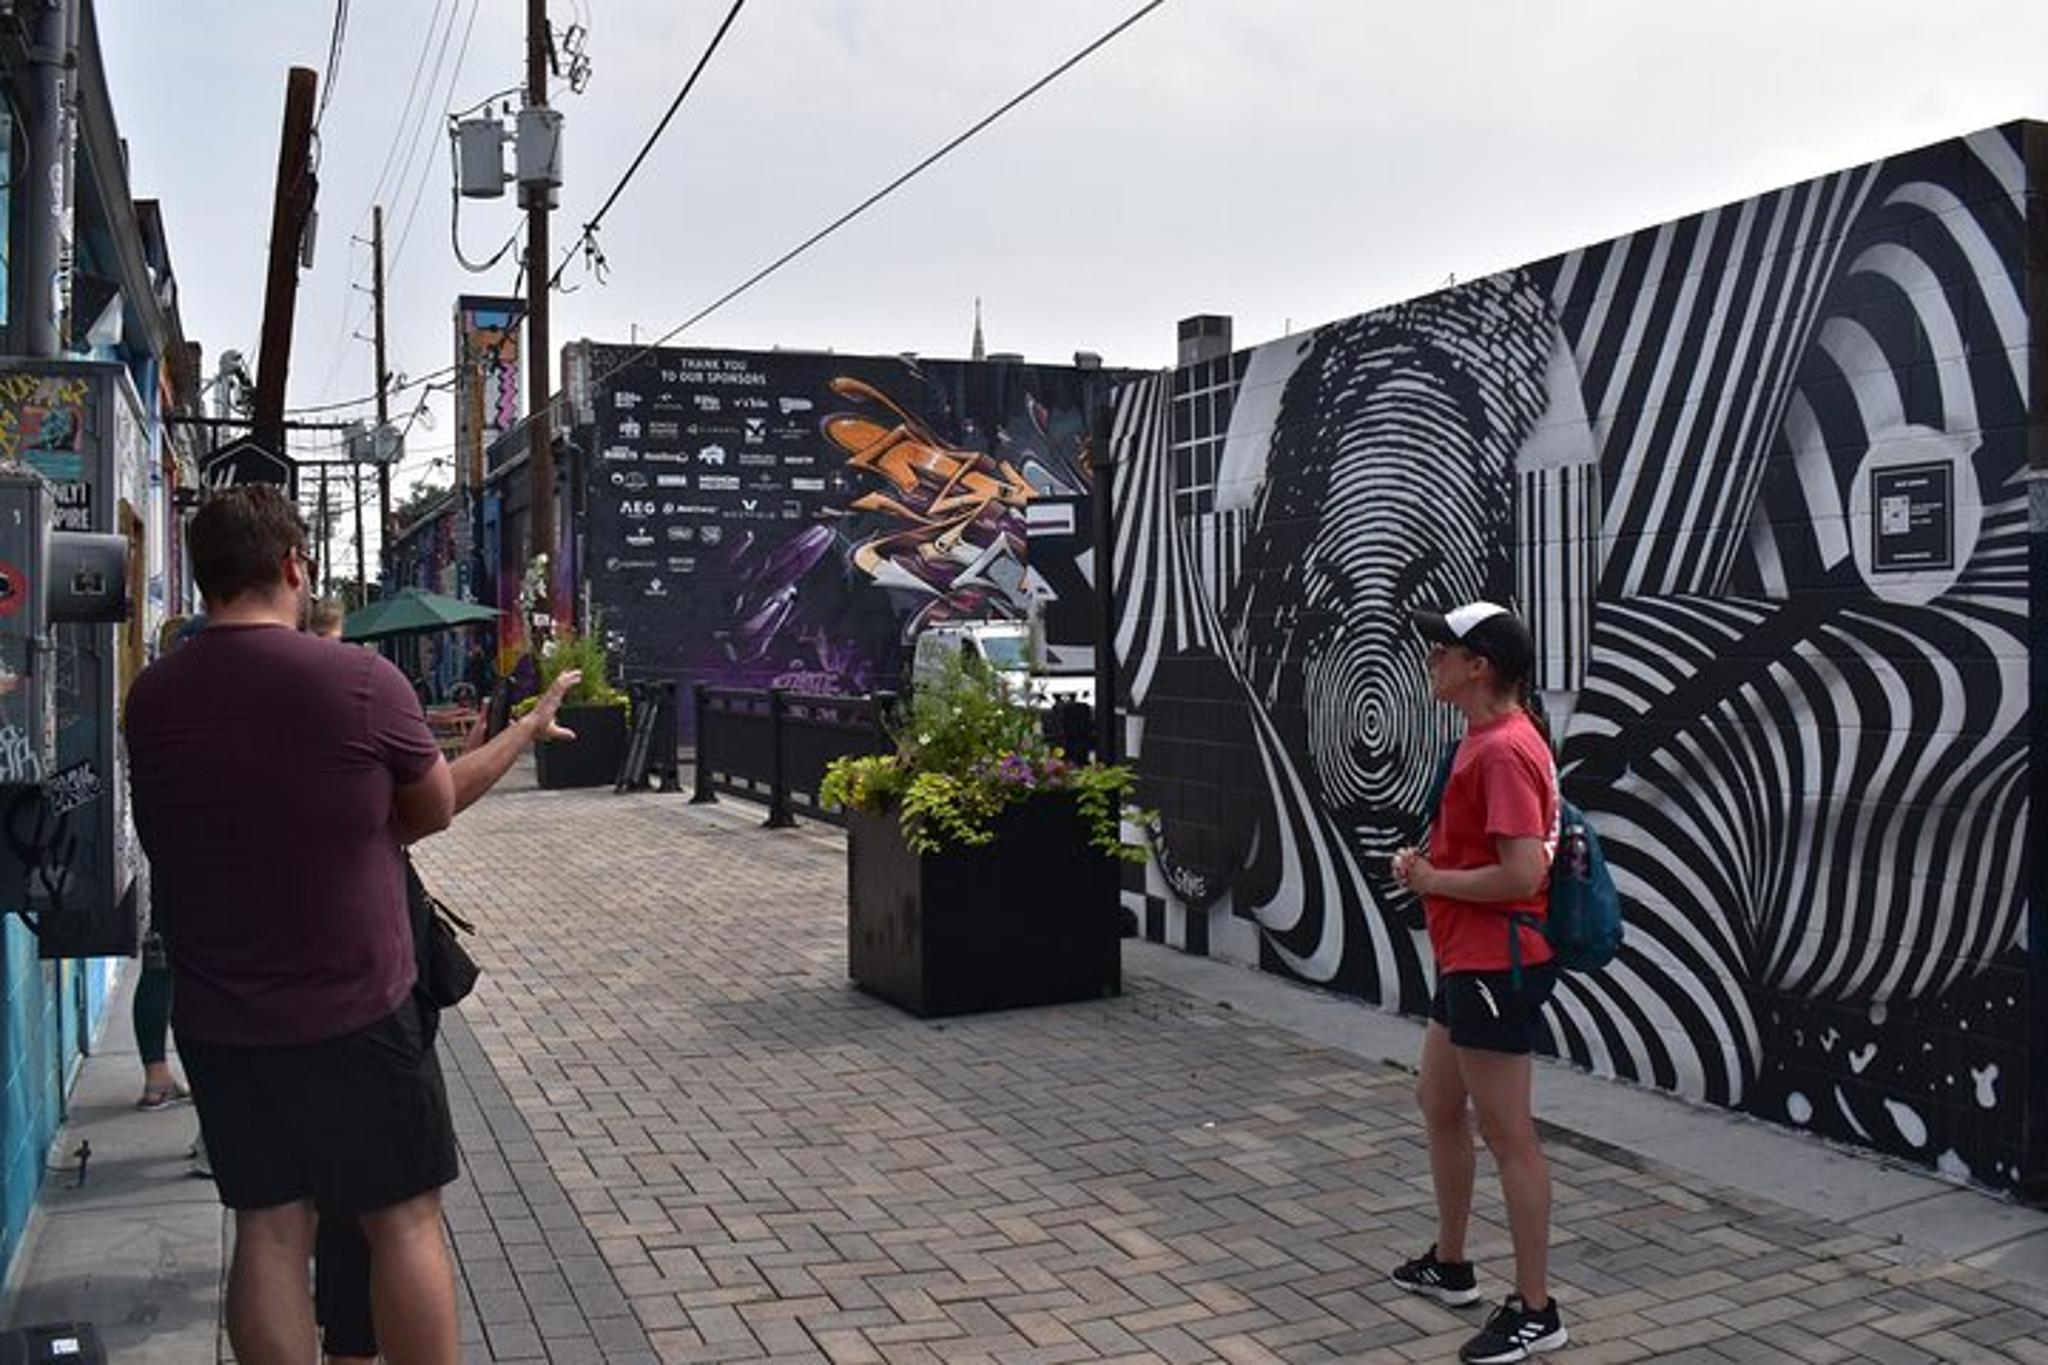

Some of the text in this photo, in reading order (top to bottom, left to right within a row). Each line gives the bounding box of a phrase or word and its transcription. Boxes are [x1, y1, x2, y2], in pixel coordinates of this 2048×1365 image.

[682, 358, 748, 371] THANK YOU
[661, 369, 766, 385] TO OUR SPONSORS
[620, 501, 655, 515] AEG
